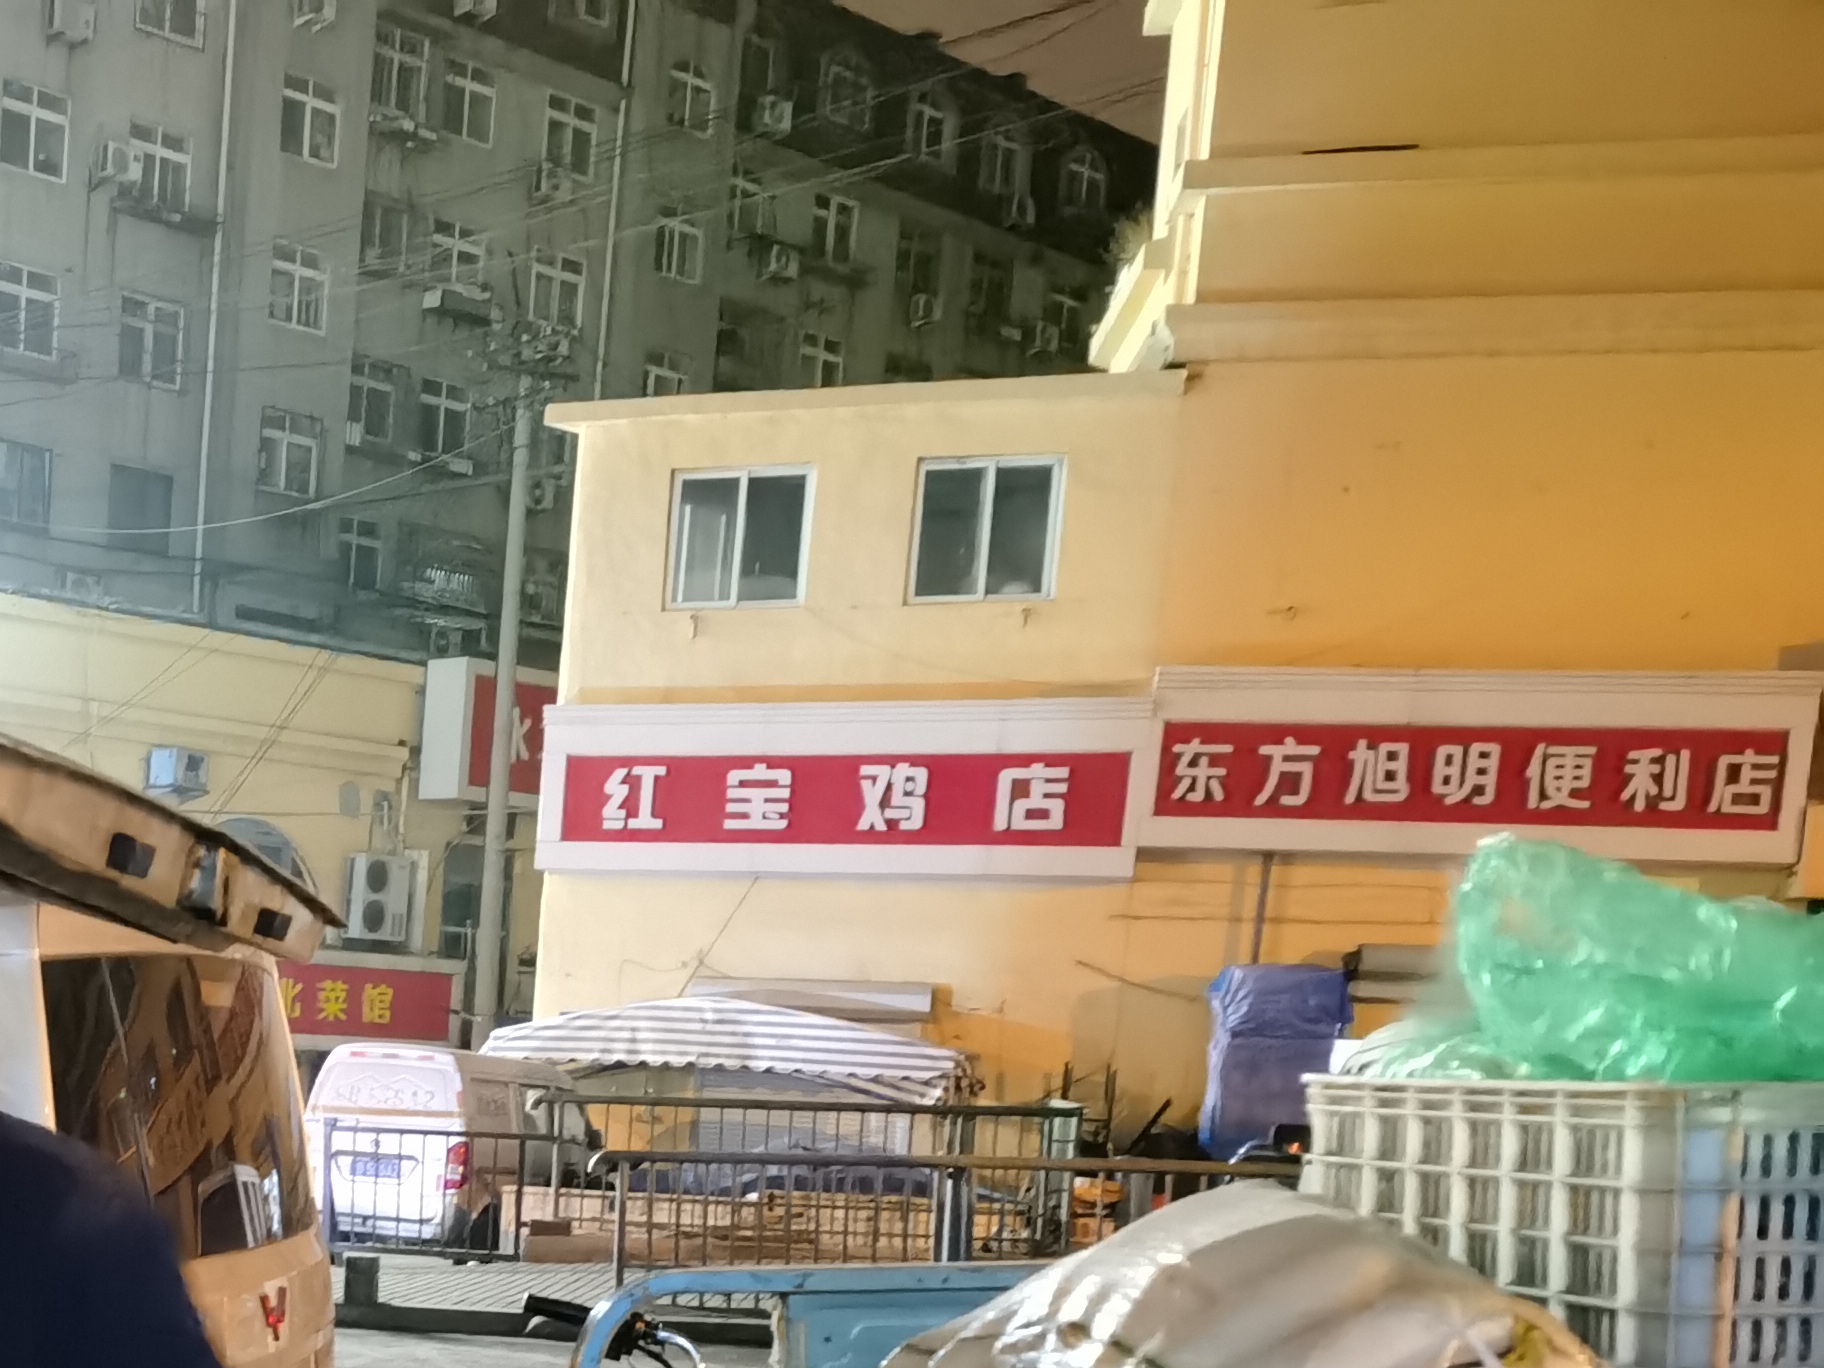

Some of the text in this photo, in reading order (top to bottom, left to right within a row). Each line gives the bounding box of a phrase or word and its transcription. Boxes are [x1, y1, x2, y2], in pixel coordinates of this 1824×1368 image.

[601, 762, 1070, 832] 红宝鸡店
[1170, 735, 1781, 815] 东方旭明便利店
